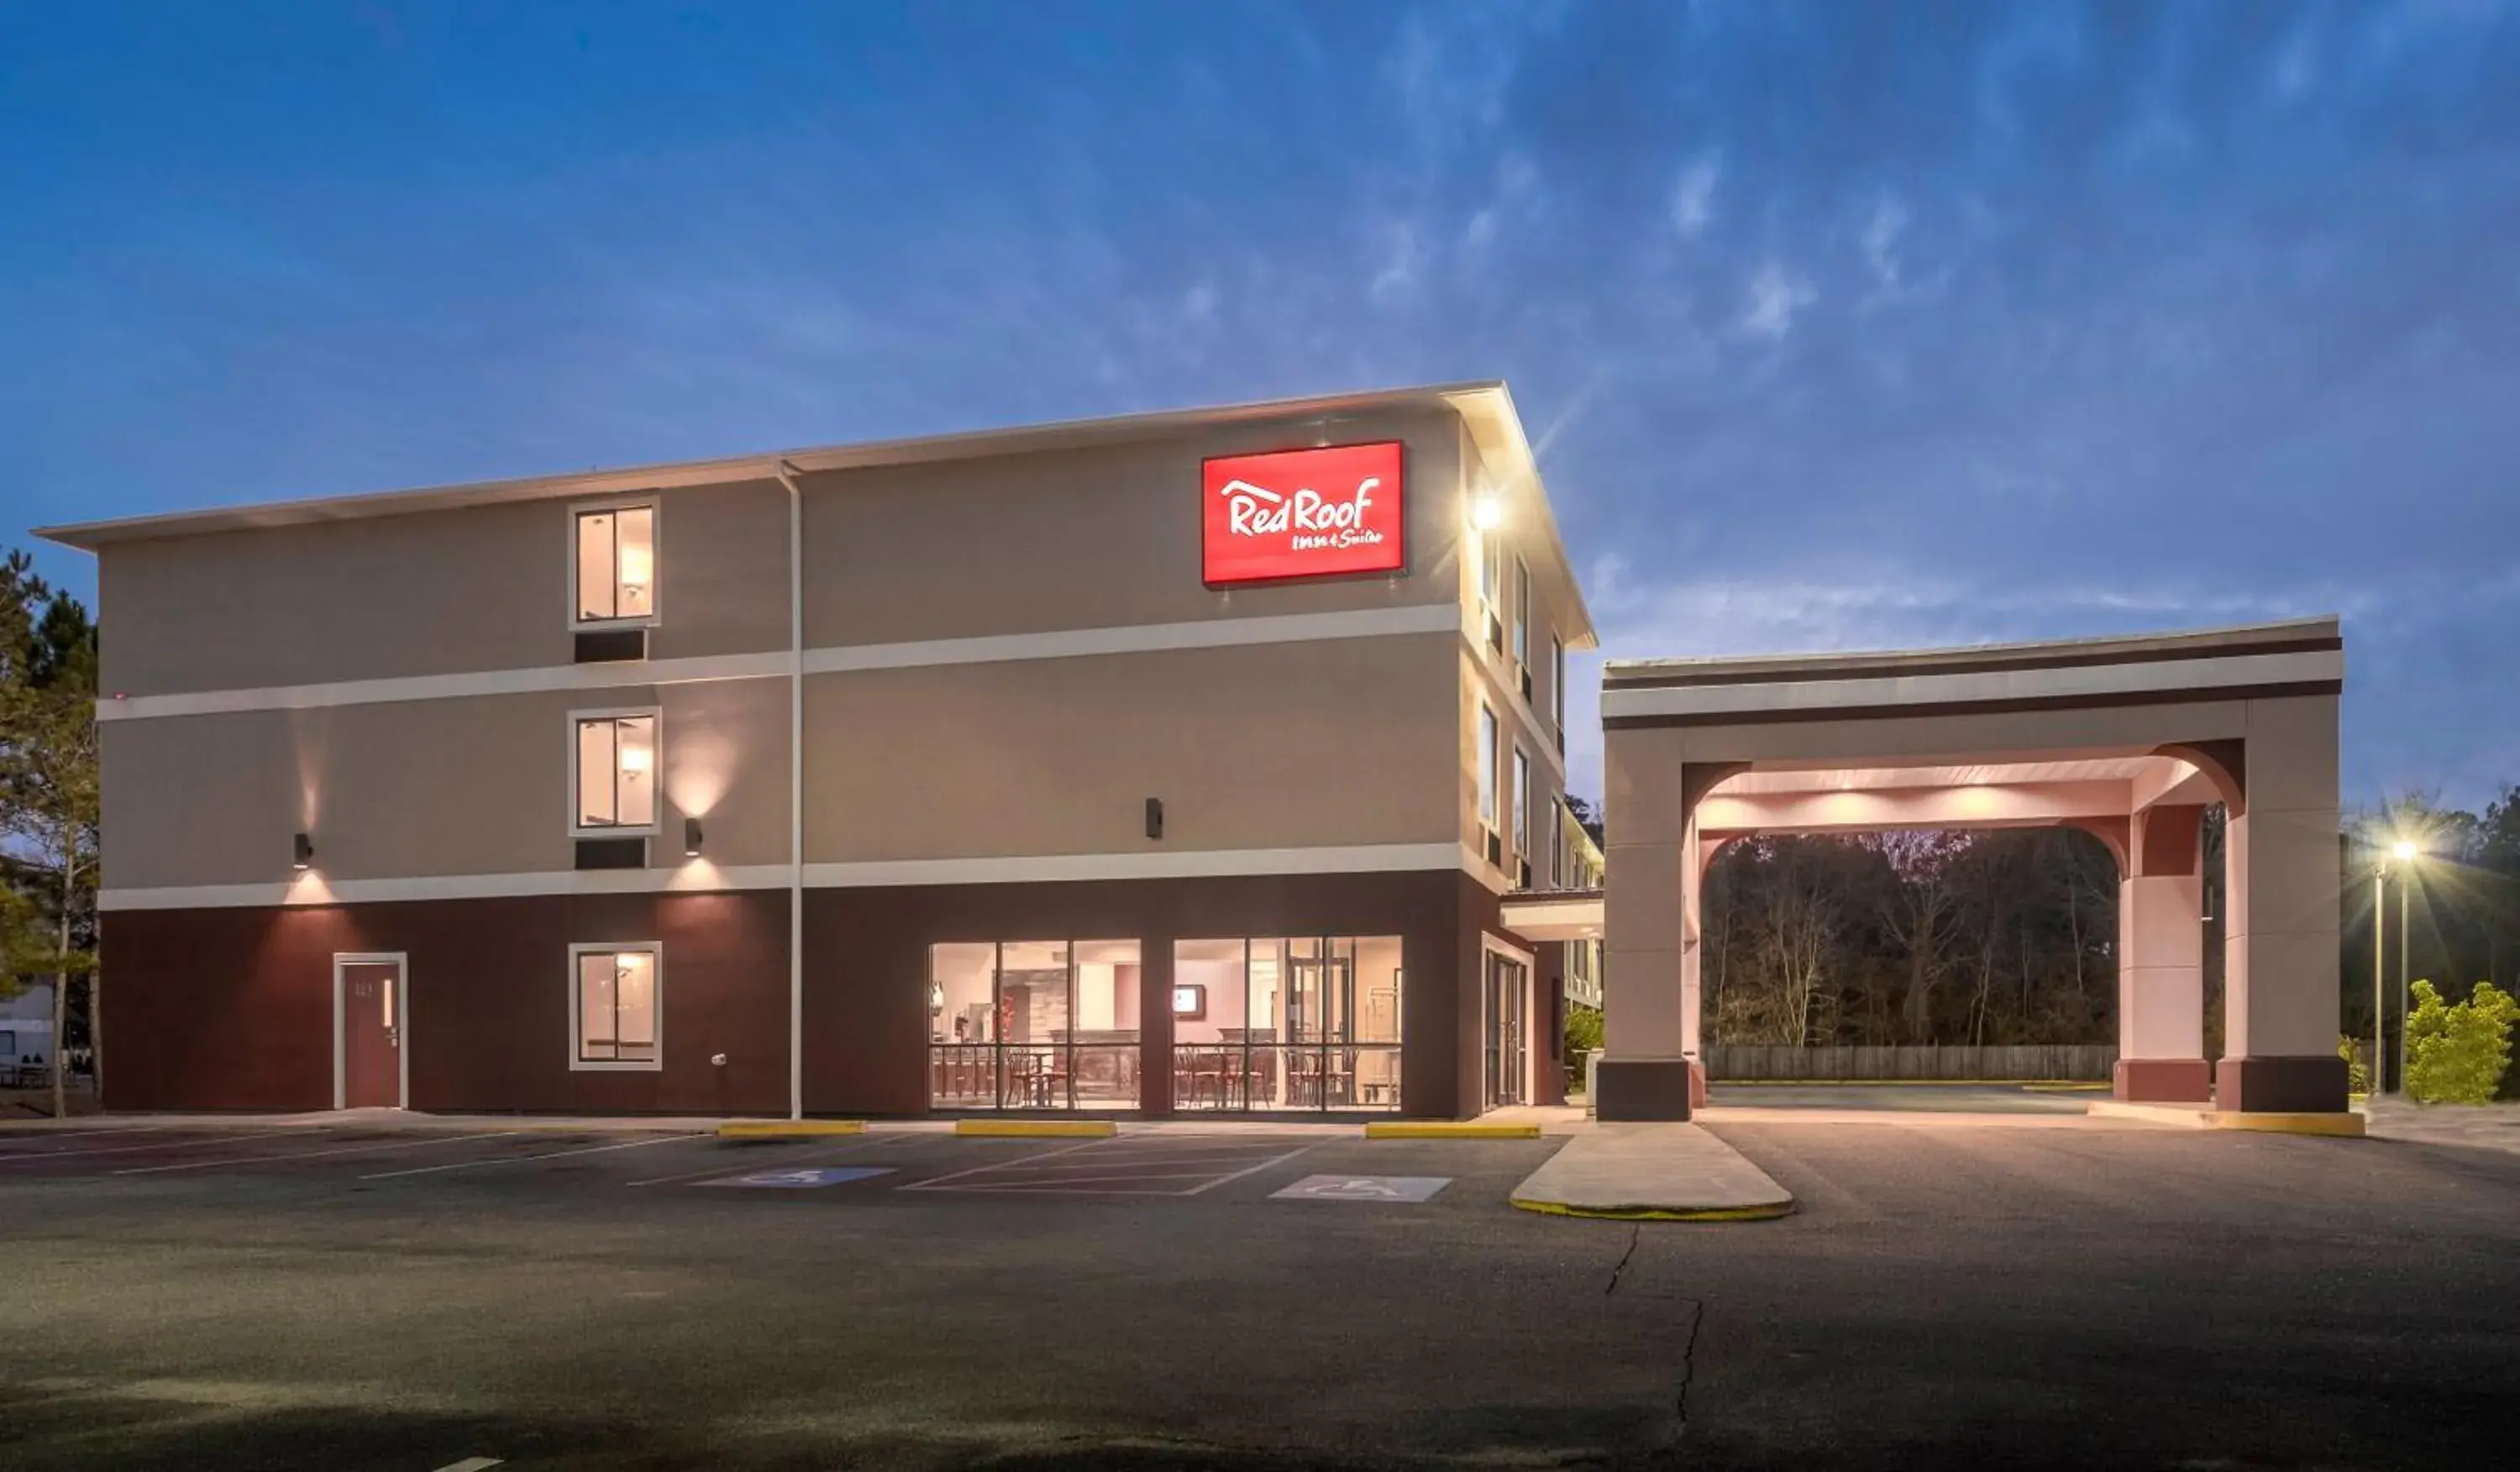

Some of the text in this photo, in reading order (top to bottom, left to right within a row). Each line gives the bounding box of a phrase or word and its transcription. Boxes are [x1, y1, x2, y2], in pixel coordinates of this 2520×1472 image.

[1230, 477, 1380, 537] Red Roof
[1292, 535, 1327, 551] Inn
